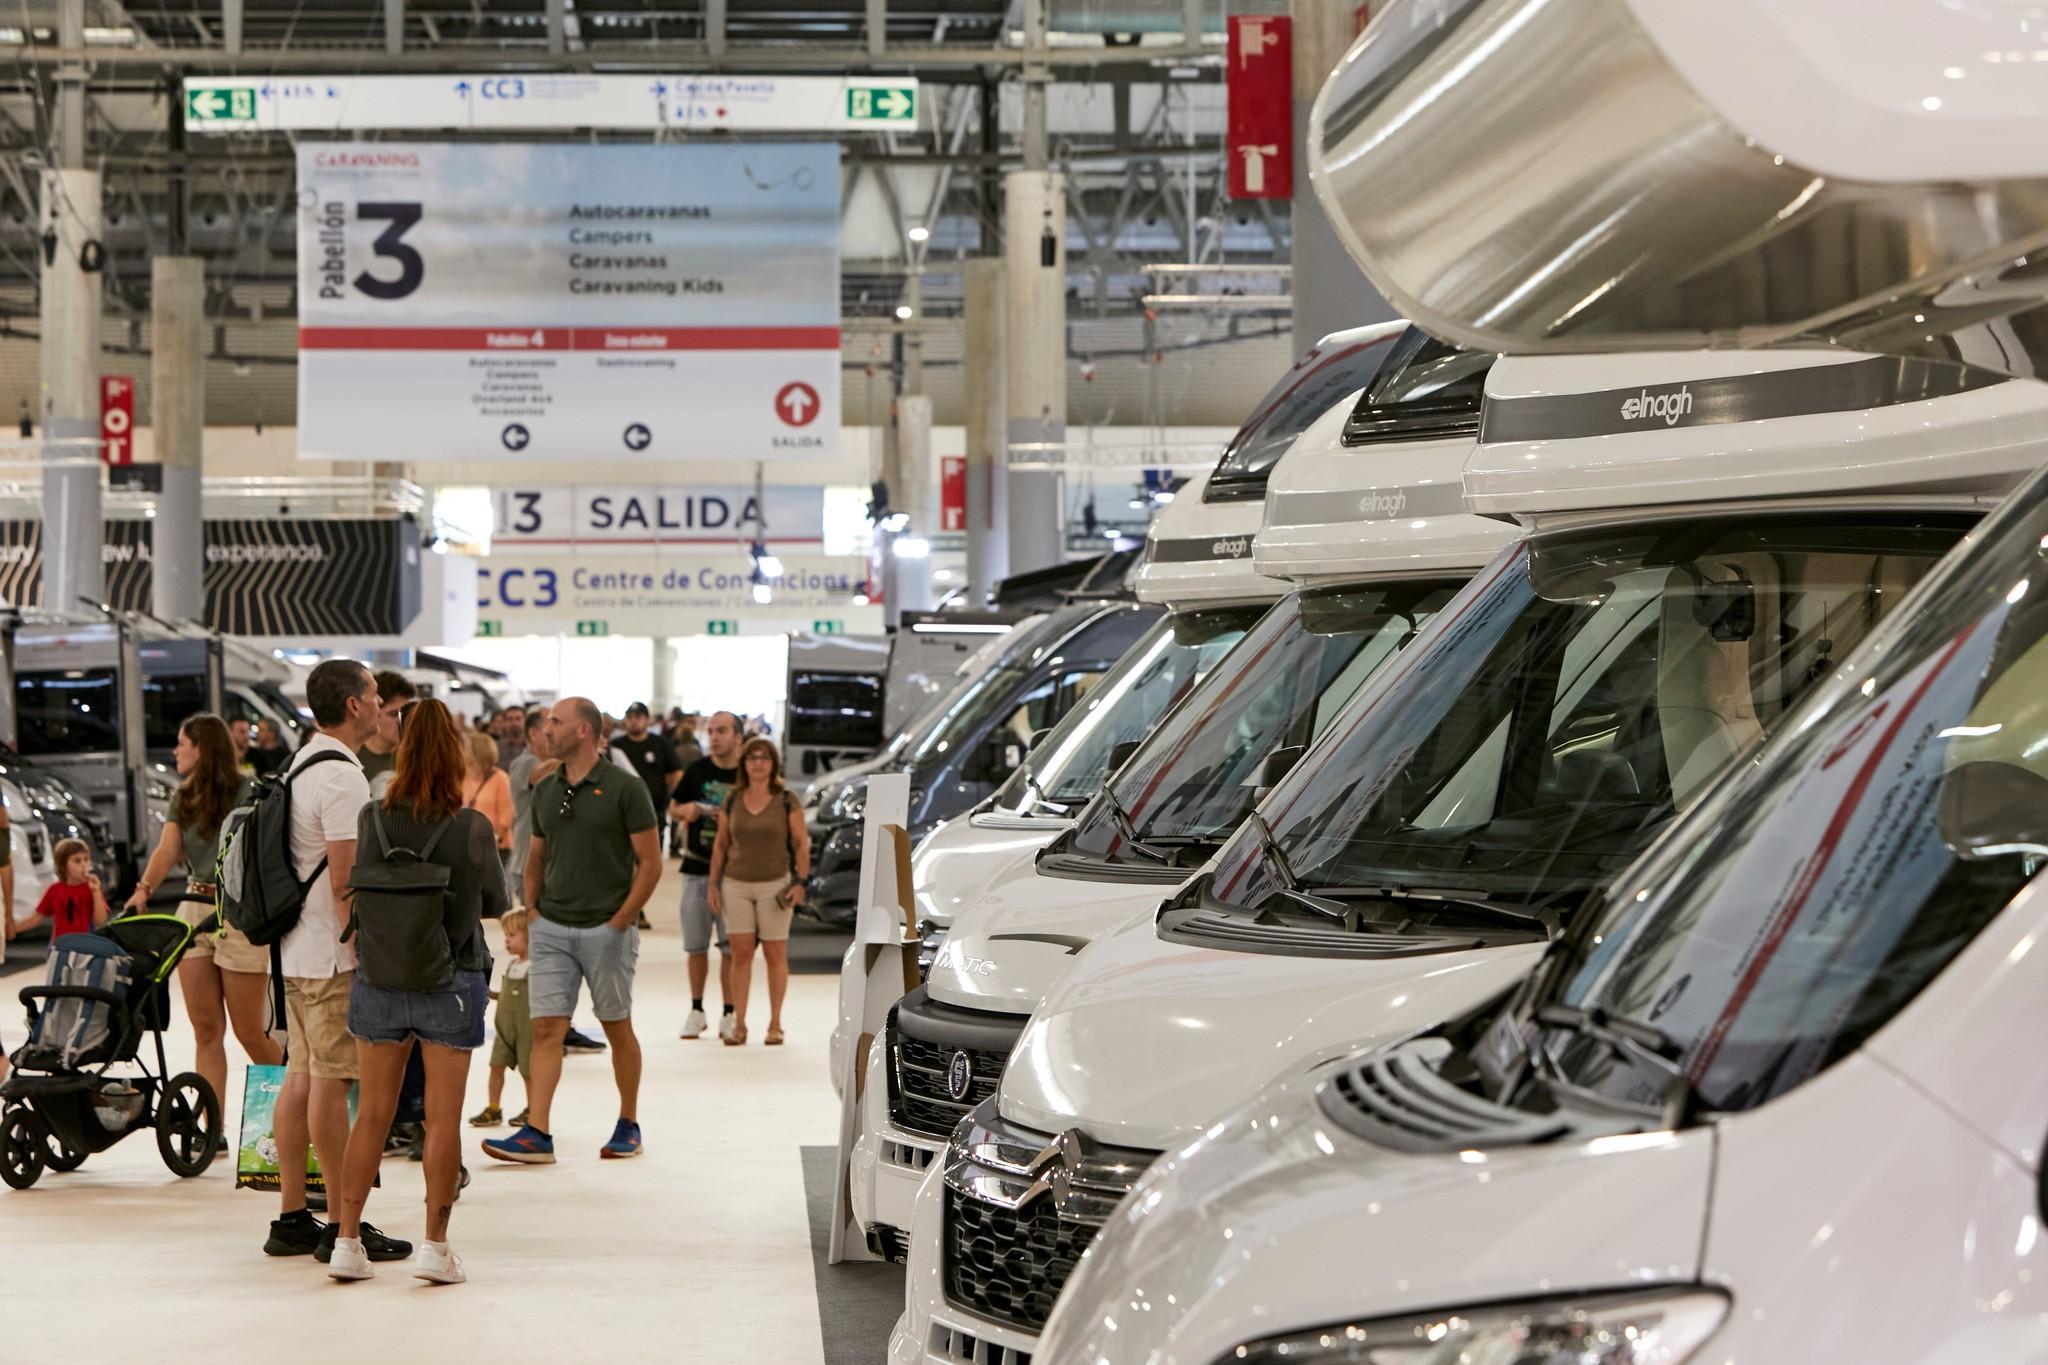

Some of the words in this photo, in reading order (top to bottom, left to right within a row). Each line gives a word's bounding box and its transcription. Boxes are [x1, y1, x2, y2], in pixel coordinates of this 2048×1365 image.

[481, 79, 526, 99] CC3
[569, 204, 711, 219] Autocaravanas
[569, 228, 653, 246] Campers
[318, 202, 345, 299] Pabellón
[354, 202, 425, 300] 3
[569, 253, 667, 268] Caravanas
[569, 279, 677, 296] Caravaning
[683, 279, 723, 293] Kids
[531, 330, 545, 347] 4
[1620, 384, 1693, 426] elnagh
[772, 437, 824, 447] SALIDA
[513, 491, 542, 533] 3
[589, 496, 768, 530] SALIDA
[1358, 489, 1407, 517] elnagh
[1212, 536, 1247, 558] elnagh
[572, 567, 653, 590] Centre
[662, 570, 690, 590] de
[698, 566, 850, 591] Conncions
